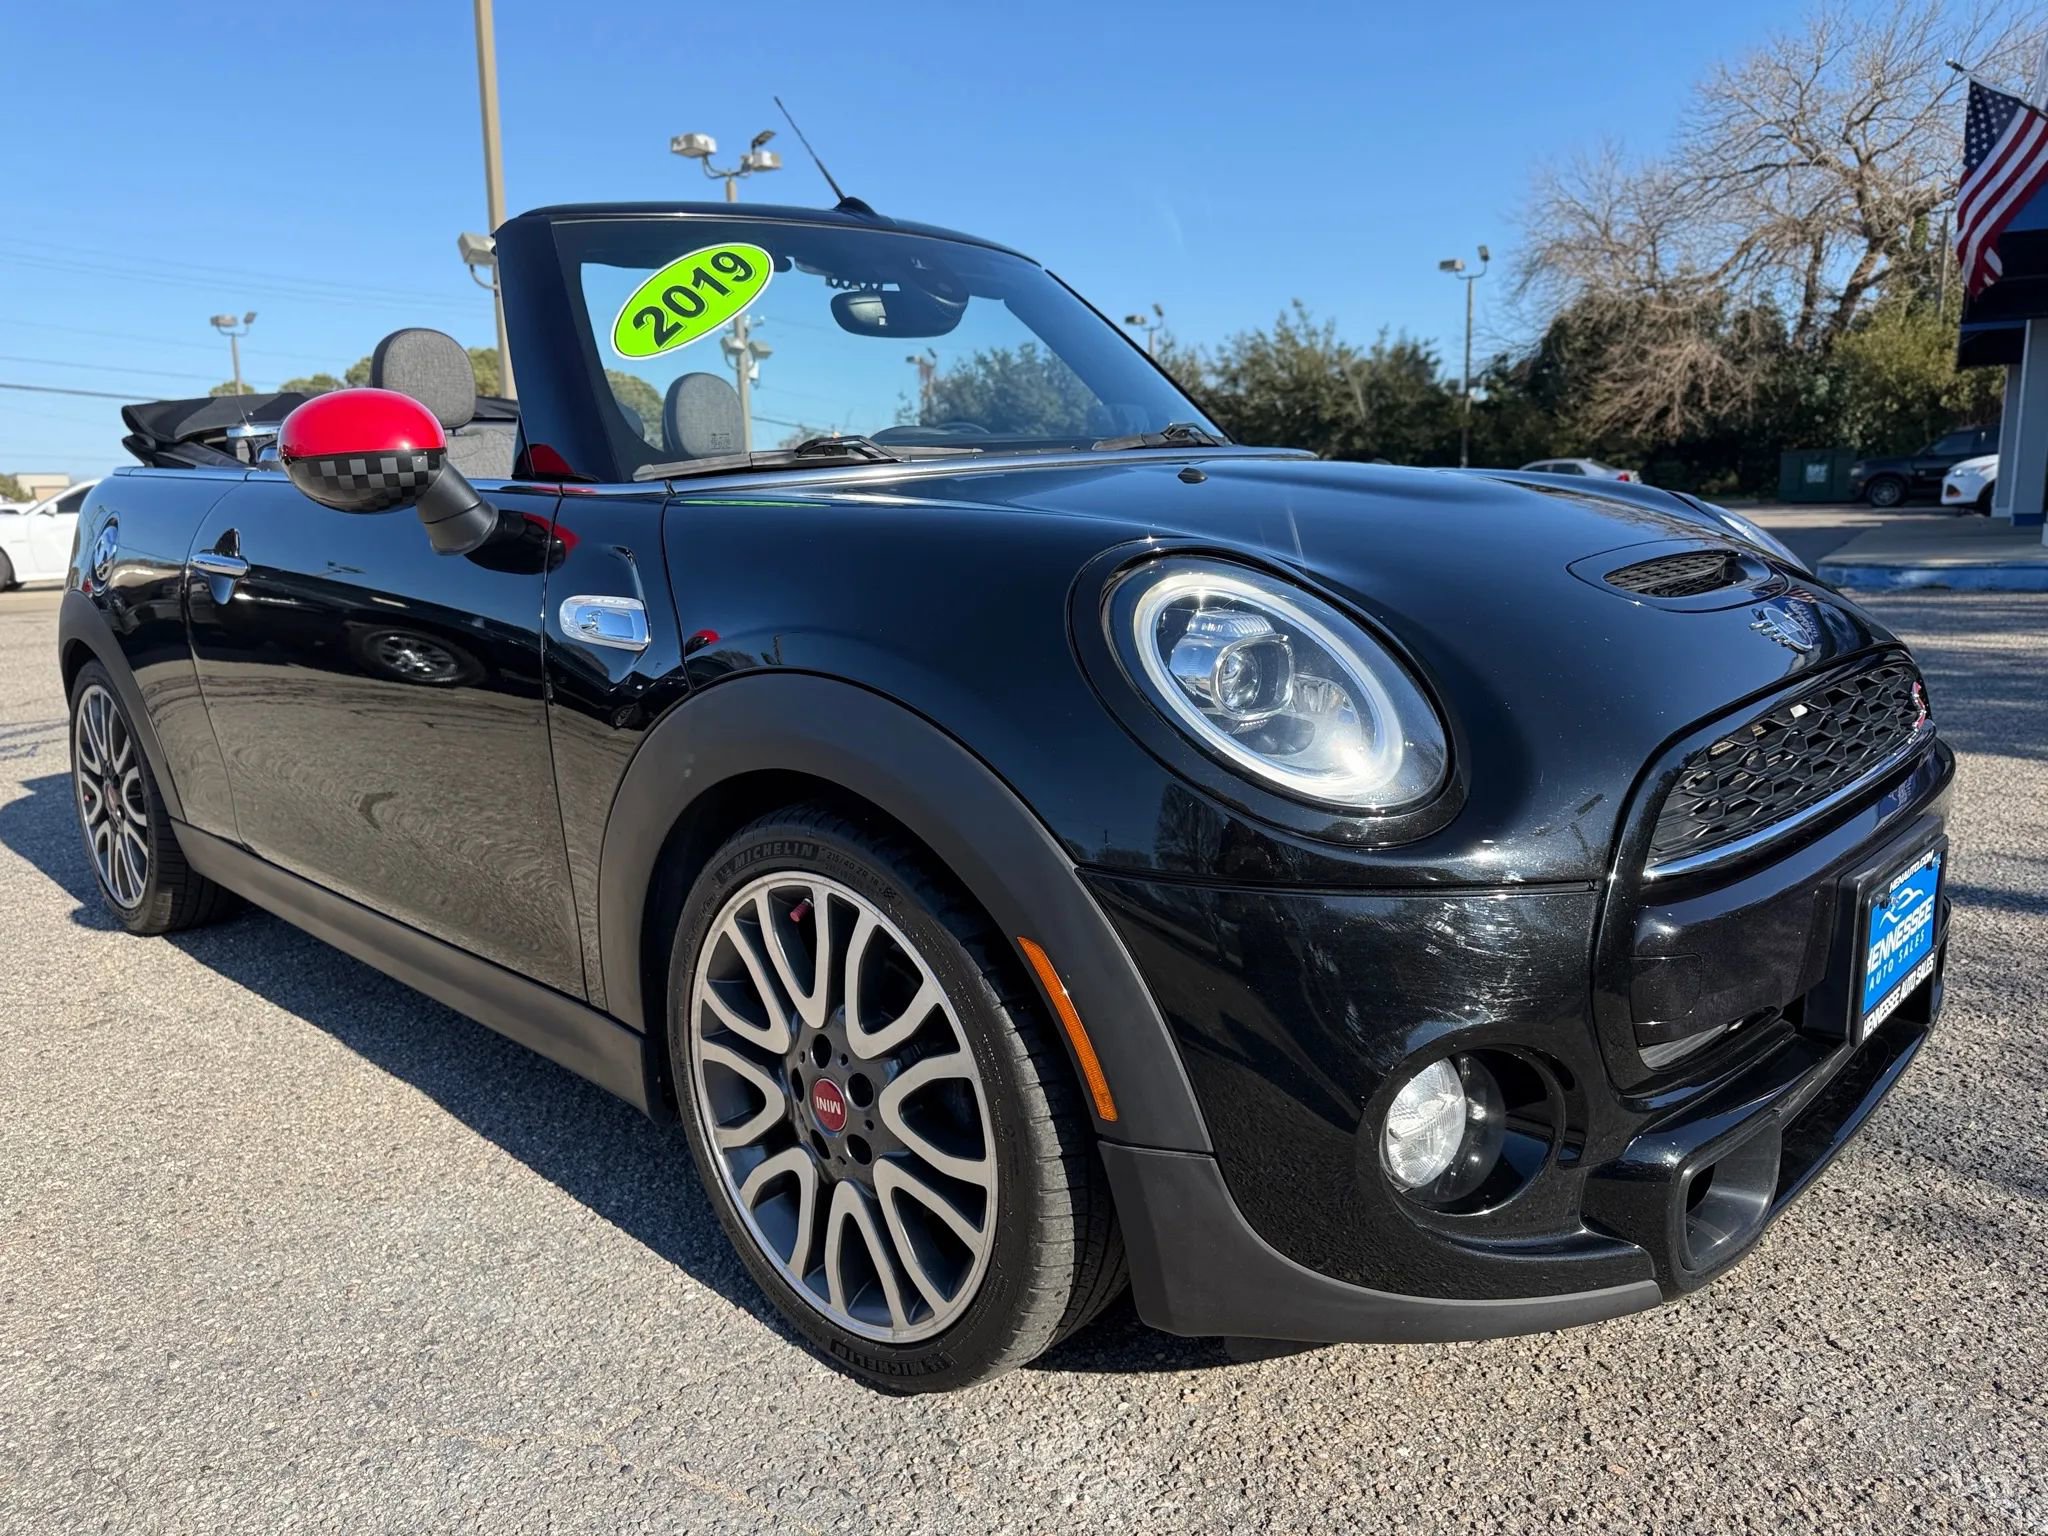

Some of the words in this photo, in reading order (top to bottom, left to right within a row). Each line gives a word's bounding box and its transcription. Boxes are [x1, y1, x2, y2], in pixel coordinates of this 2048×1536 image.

[632, 251, 754, 348] 2019
[733, 841, 815, 869] MICHELIN
[1888, 849, 1935, 894] HENAUTO.COM
[1868, 960, 1895, 992] AUTO
[1898, 929, 1926, 963] SALES
[1862, 984, 1901, 1041] HENNESSEE
[1900, 969, 1917, 1003] AUTO
[1915, 952, 1935, 986] SALES
[816, 1096, 842, 1115] MINI
[835, 1341, 926, 1376] MICHELIN
